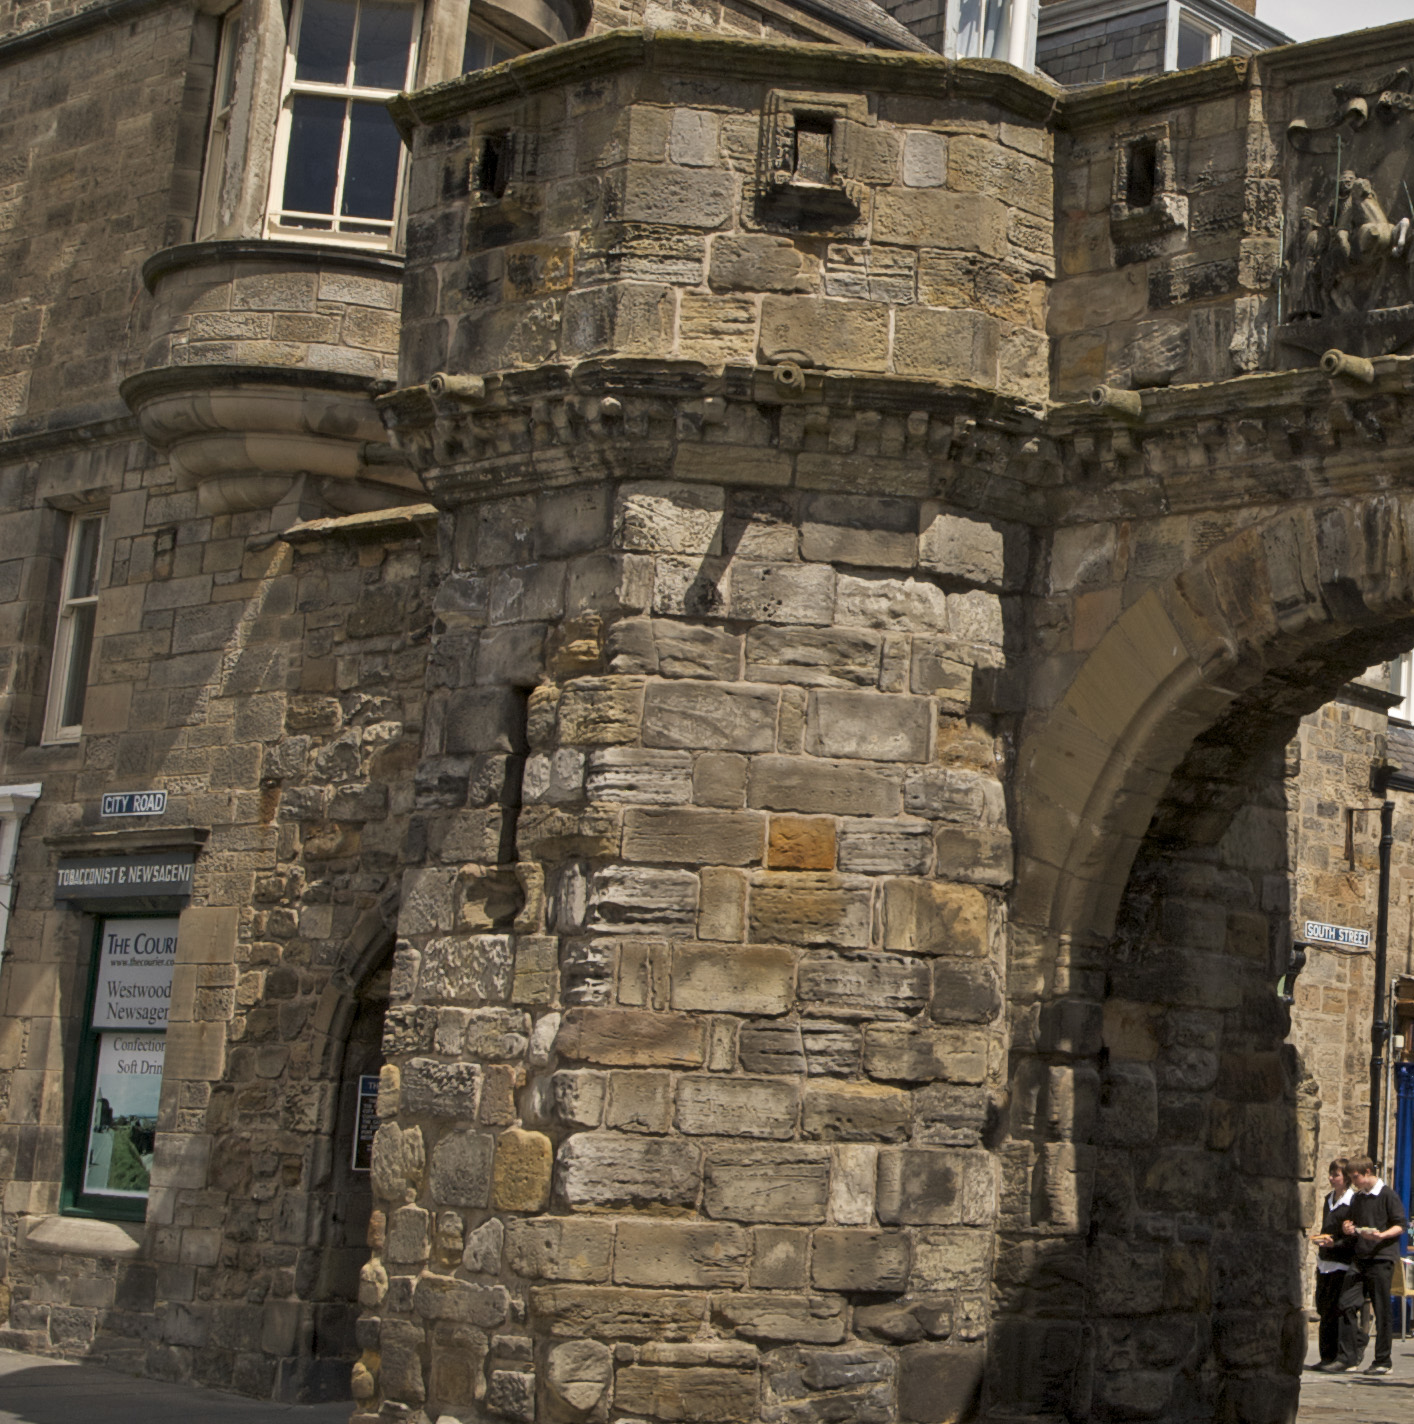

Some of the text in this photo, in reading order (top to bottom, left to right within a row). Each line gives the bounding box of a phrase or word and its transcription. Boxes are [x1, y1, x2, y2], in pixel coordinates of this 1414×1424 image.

[105, 794, 163, 813] CITY ROAD
[57, 864, 192, 886] TOBACCONIST & NEWSAGENT
[108, 933, 131, 954] THE
[1307, 924, 1368, 945] SOUTH STREET
[108, 981, 172, 998] Westwood
[117, 1059, 137, 1074] Soft
